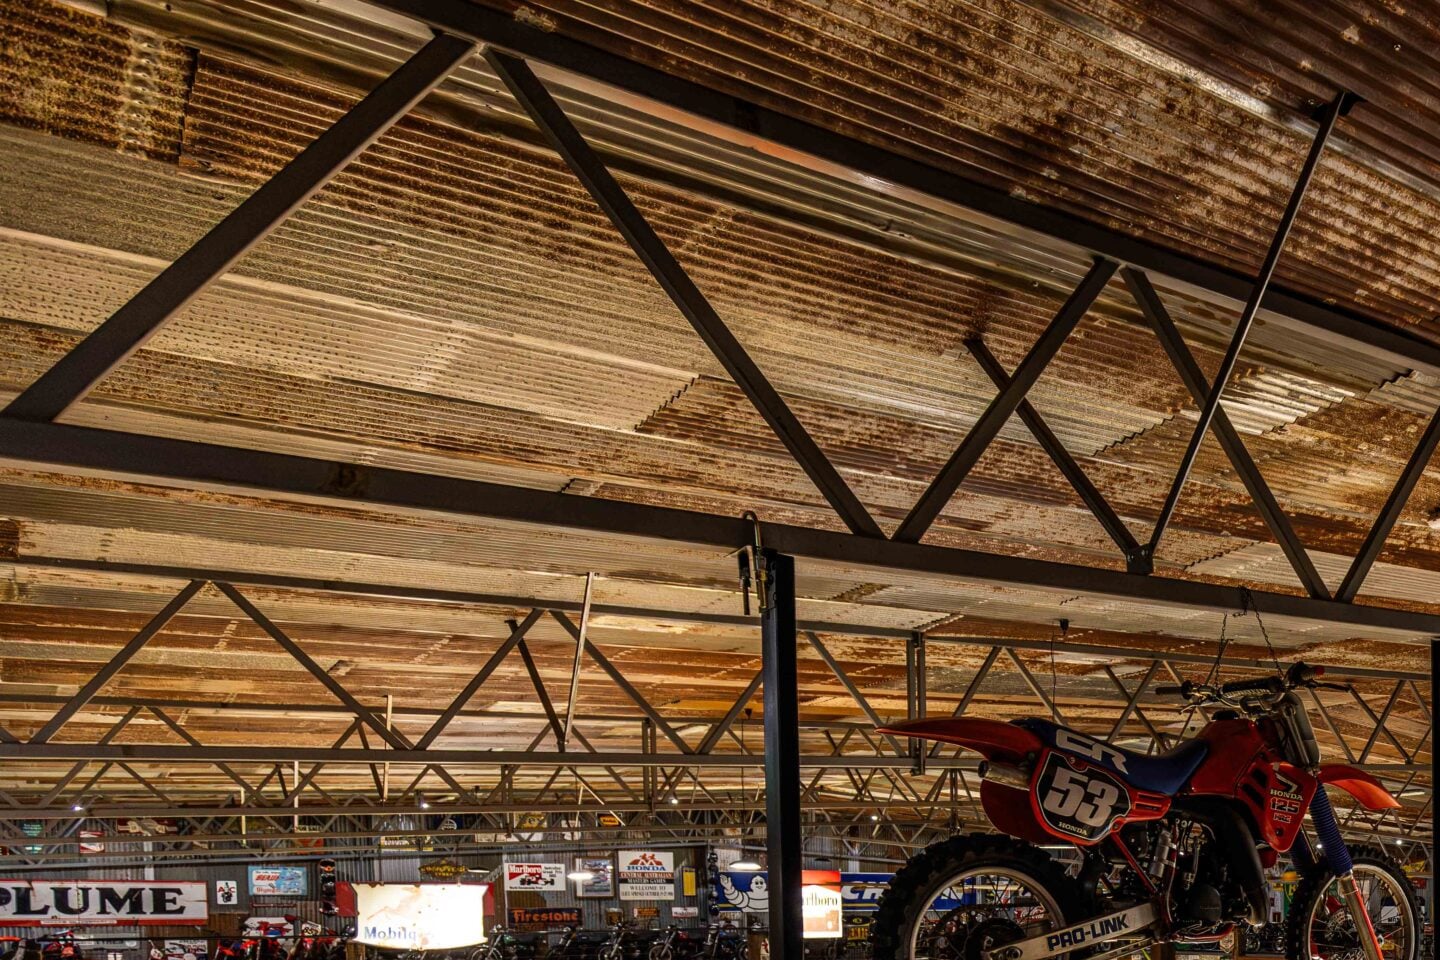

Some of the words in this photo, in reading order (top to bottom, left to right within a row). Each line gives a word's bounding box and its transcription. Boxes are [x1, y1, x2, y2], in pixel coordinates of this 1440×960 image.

[1043, 766, 1119, 827] 53
[1270, 788, 1303, 800] HONDA
[1269, 798, 1300, 814] 125
[1058, 821, 1088, 836] HONDA
[508, 865, 541, 875] Marlboro
[513, 909, 579, 922] Firestone
[1047, 912, 1129, 952] PRO-LINK
